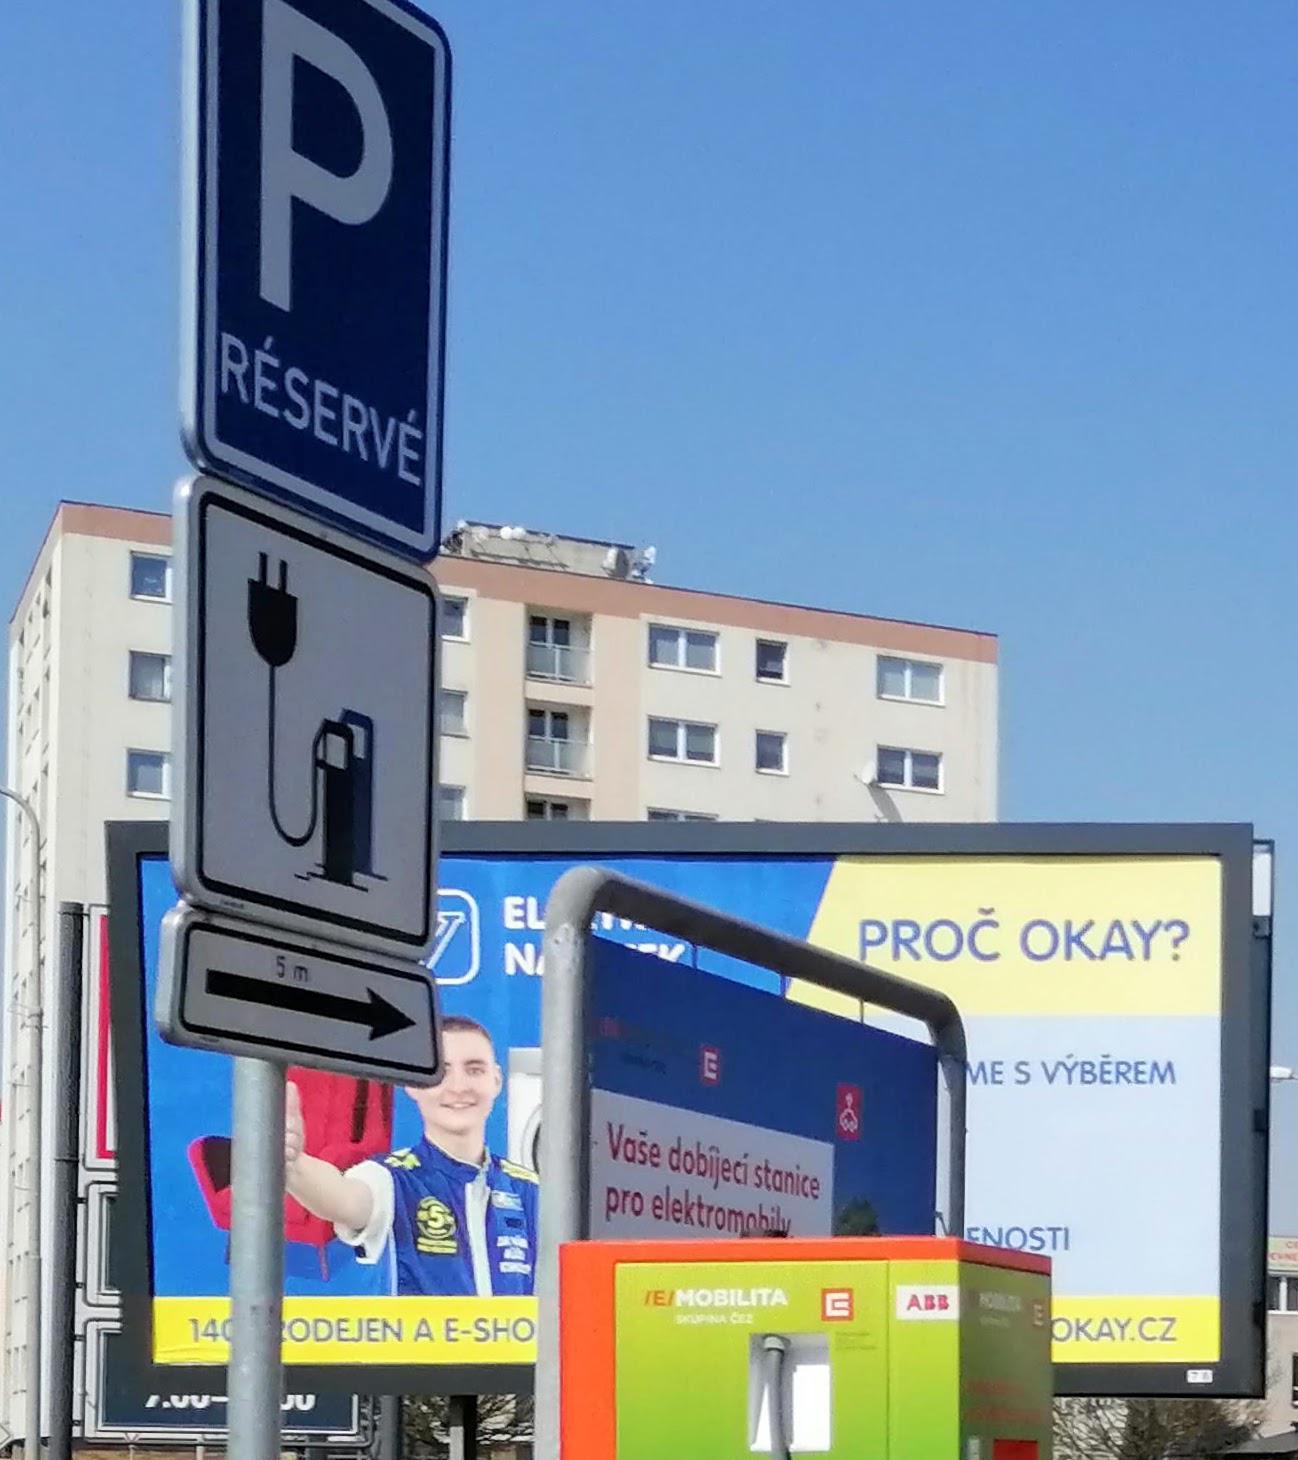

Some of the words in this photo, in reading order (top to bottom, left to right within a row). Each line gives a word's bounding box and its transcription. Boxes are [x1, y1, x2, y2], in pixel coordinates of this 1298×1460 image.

[260, 0, 394, 312] P
[220, 332, 423, 487] RÉSERVÉ
[859, 907, 1001, 962] PROČ
[1020, 918, 1190, 962] OKAY?
[276, 955, 286, 978] 5
[293, 964, 309, 982] m
[966, 1061, 1005, 1085] ME
[1014, 1061, 1031, 1085] S
[1041, 1053, 1177, 1085] VÝBĚREM
[607, 1121, 661, 1168] Vaše
[668, 1136, 750, 1190] dobíjecí
[754, 1159, 820, 1200] stanice
[605, 1185, 645, 1222] pro
[652, 1184, 791, 1237] elektromobily
[966, 1227, 1070, 1250] ENOSTI
[907, 1294, 949, 1311] ABB
[414, 1319, 434, 1342] A
[445, 1318, 536, 1342] E-SHO
